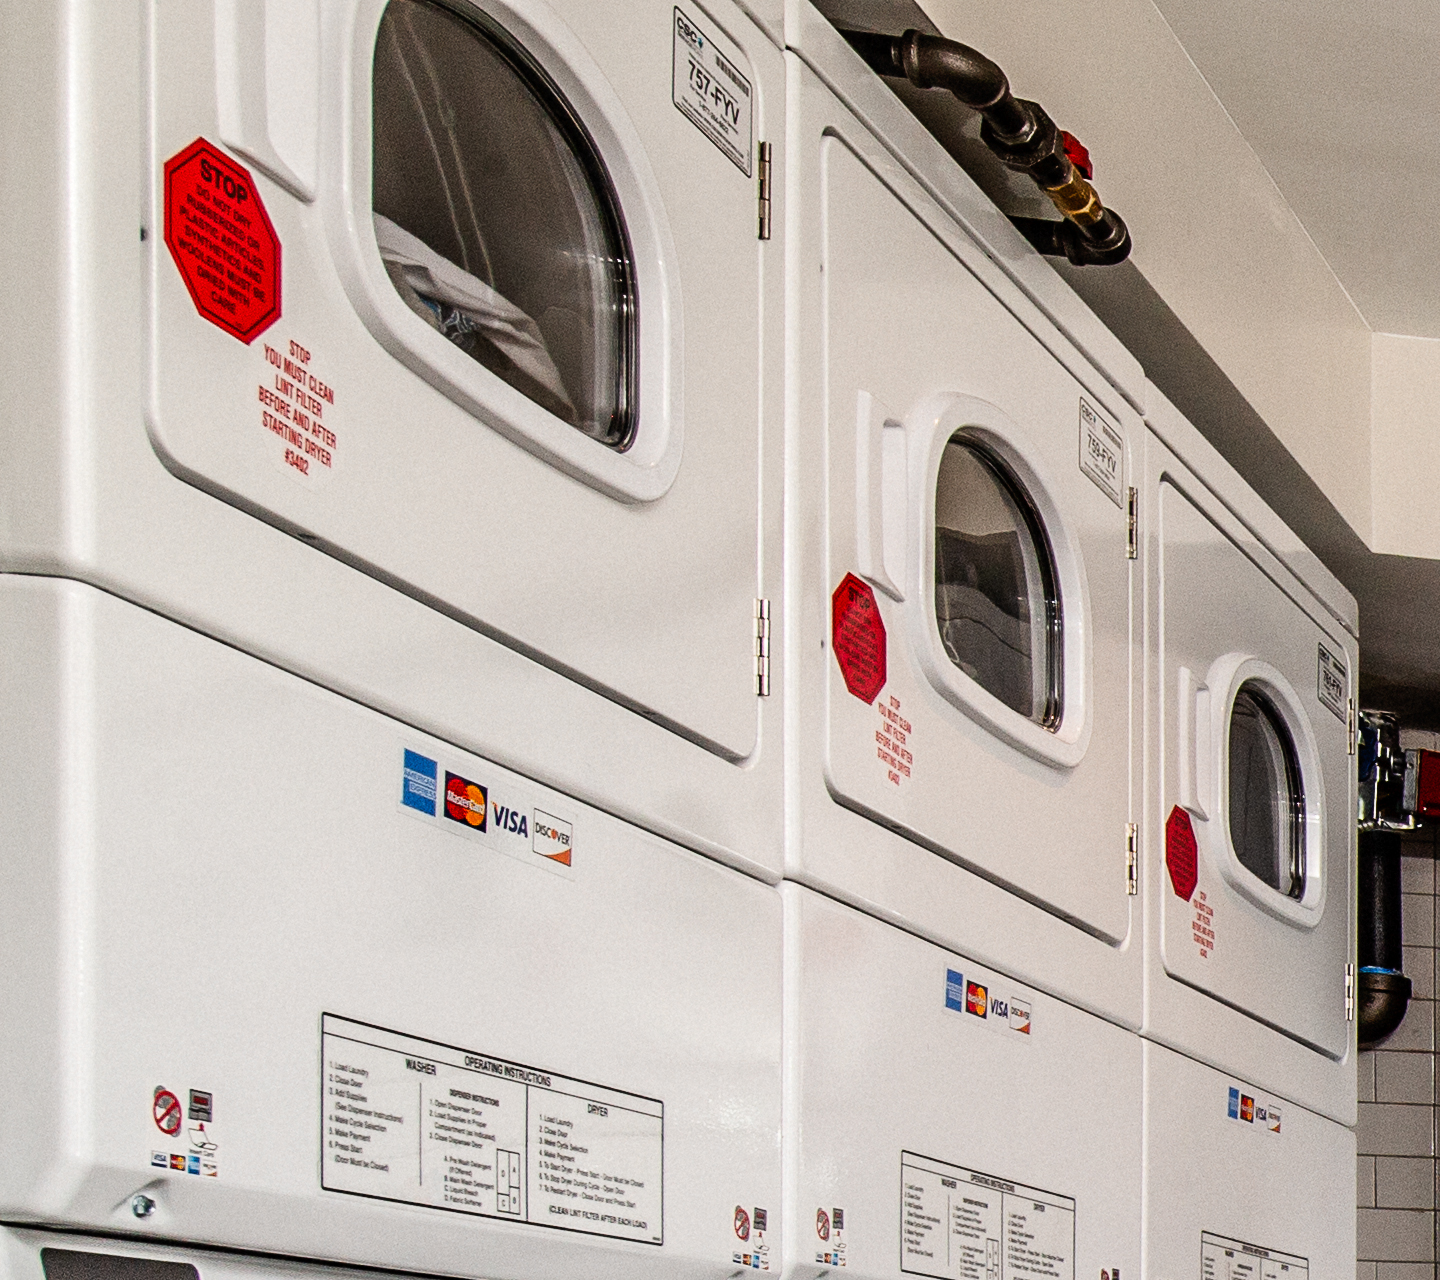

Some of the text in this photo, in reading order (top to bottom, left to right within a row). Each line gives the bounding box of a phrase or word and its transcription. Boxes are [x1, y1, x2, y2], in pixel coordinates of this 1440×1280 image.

[677, 17, 697, 43] CSC
[688, 59, 740, 125] 757-FYV
[200, 156, 247, 209] STOP
[289, 340, 311, 365] STOP
[264, 343, 334, 405] YOU MUST CLEAN
[275, 374, 322, 418] LINT FILTER
[258, 385, 337, 450] BEFORE AND AFTER
[262, 411, 332, 468] STARTING DRYER
[1087, 433, 1117, 473] 759-FYV
[849, 586, 871, 610] STOP
[403, 767, 436, 789] AMERICAN
[446, 790, 486, 815] MasterCard
[491, 801, 529, 838] VISA
[535, 822, 570, 846] DISCOVER
[989, 996, 1008, 1019] VISA
[405, 1058, 436, 1075] WASHER
[464, 1054, 551, 1087] OPERATING INSTRUCTIONS
[587, 1103, 608, 1117] DRYER
[549, 1204, 647, 1229] (CLEAN LINT FILTER AFTER EACH LOAD)
